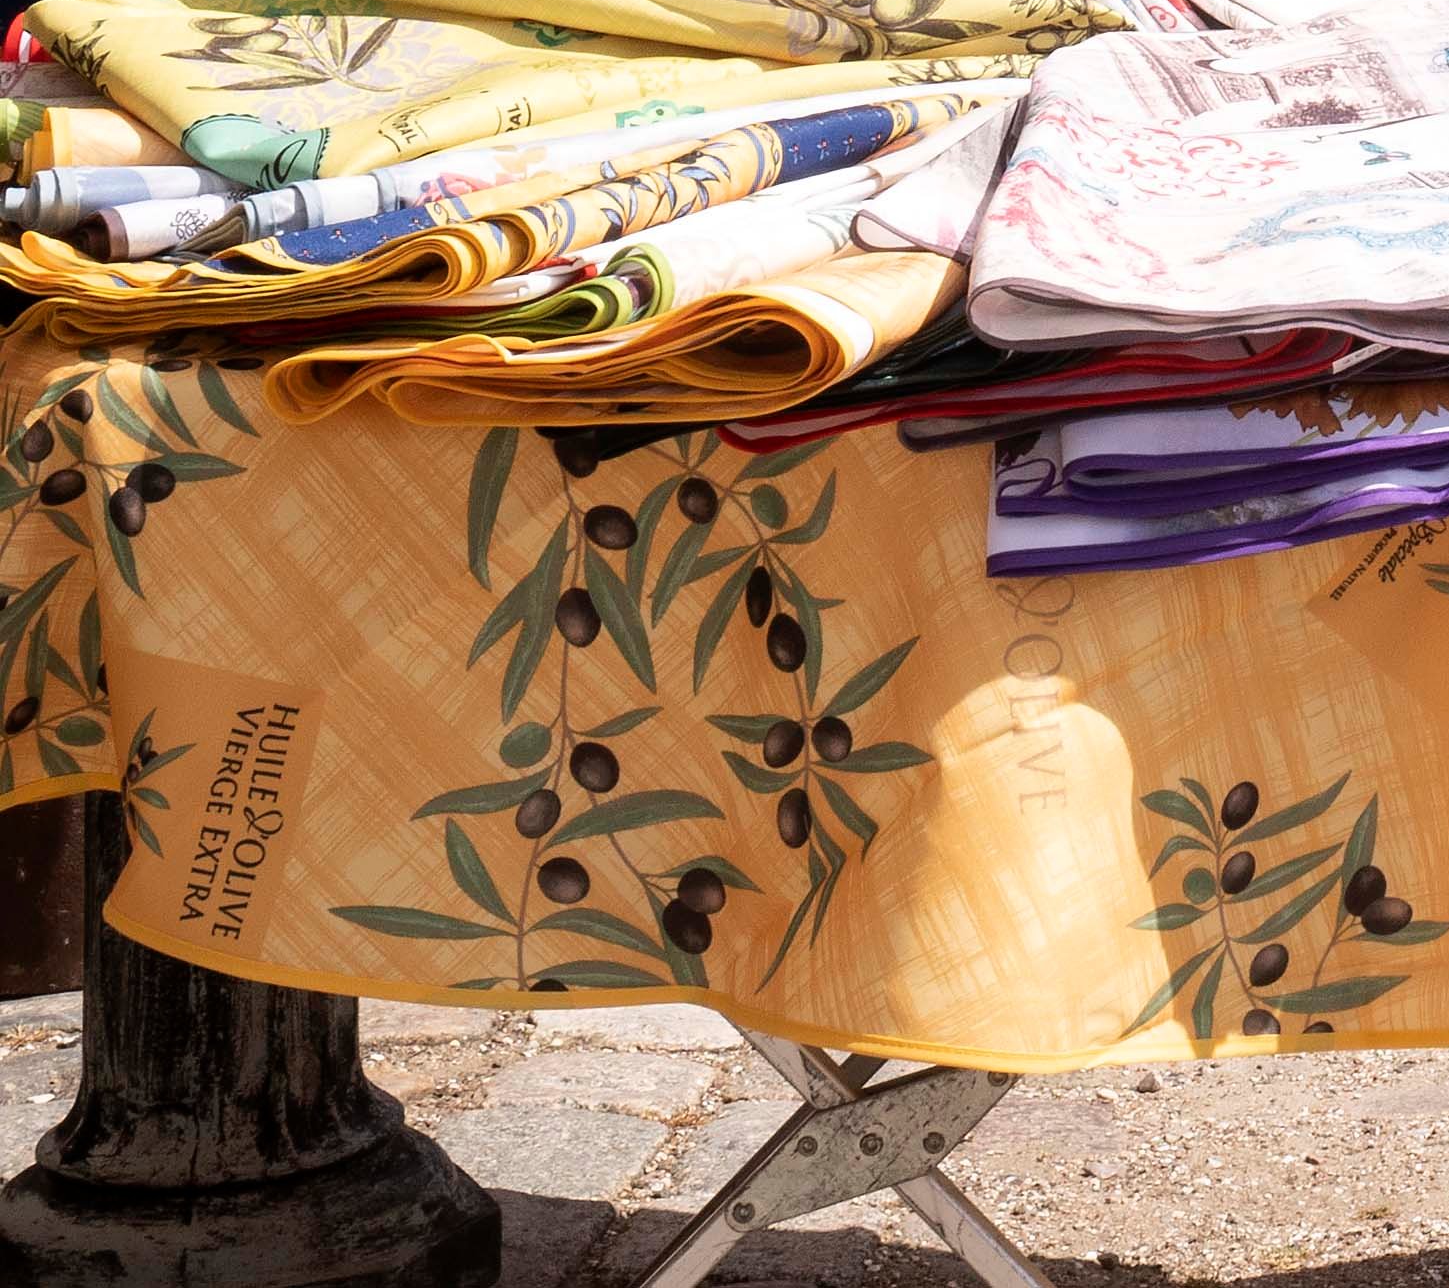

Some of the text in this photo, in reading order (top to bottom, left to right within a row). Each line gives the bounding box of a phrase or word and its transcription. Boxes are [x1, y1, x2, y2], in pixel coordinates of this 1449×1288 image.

[179, 705, 266, 922] VIERGE EXTRA
[247, 702, 301, 804] HUILE
